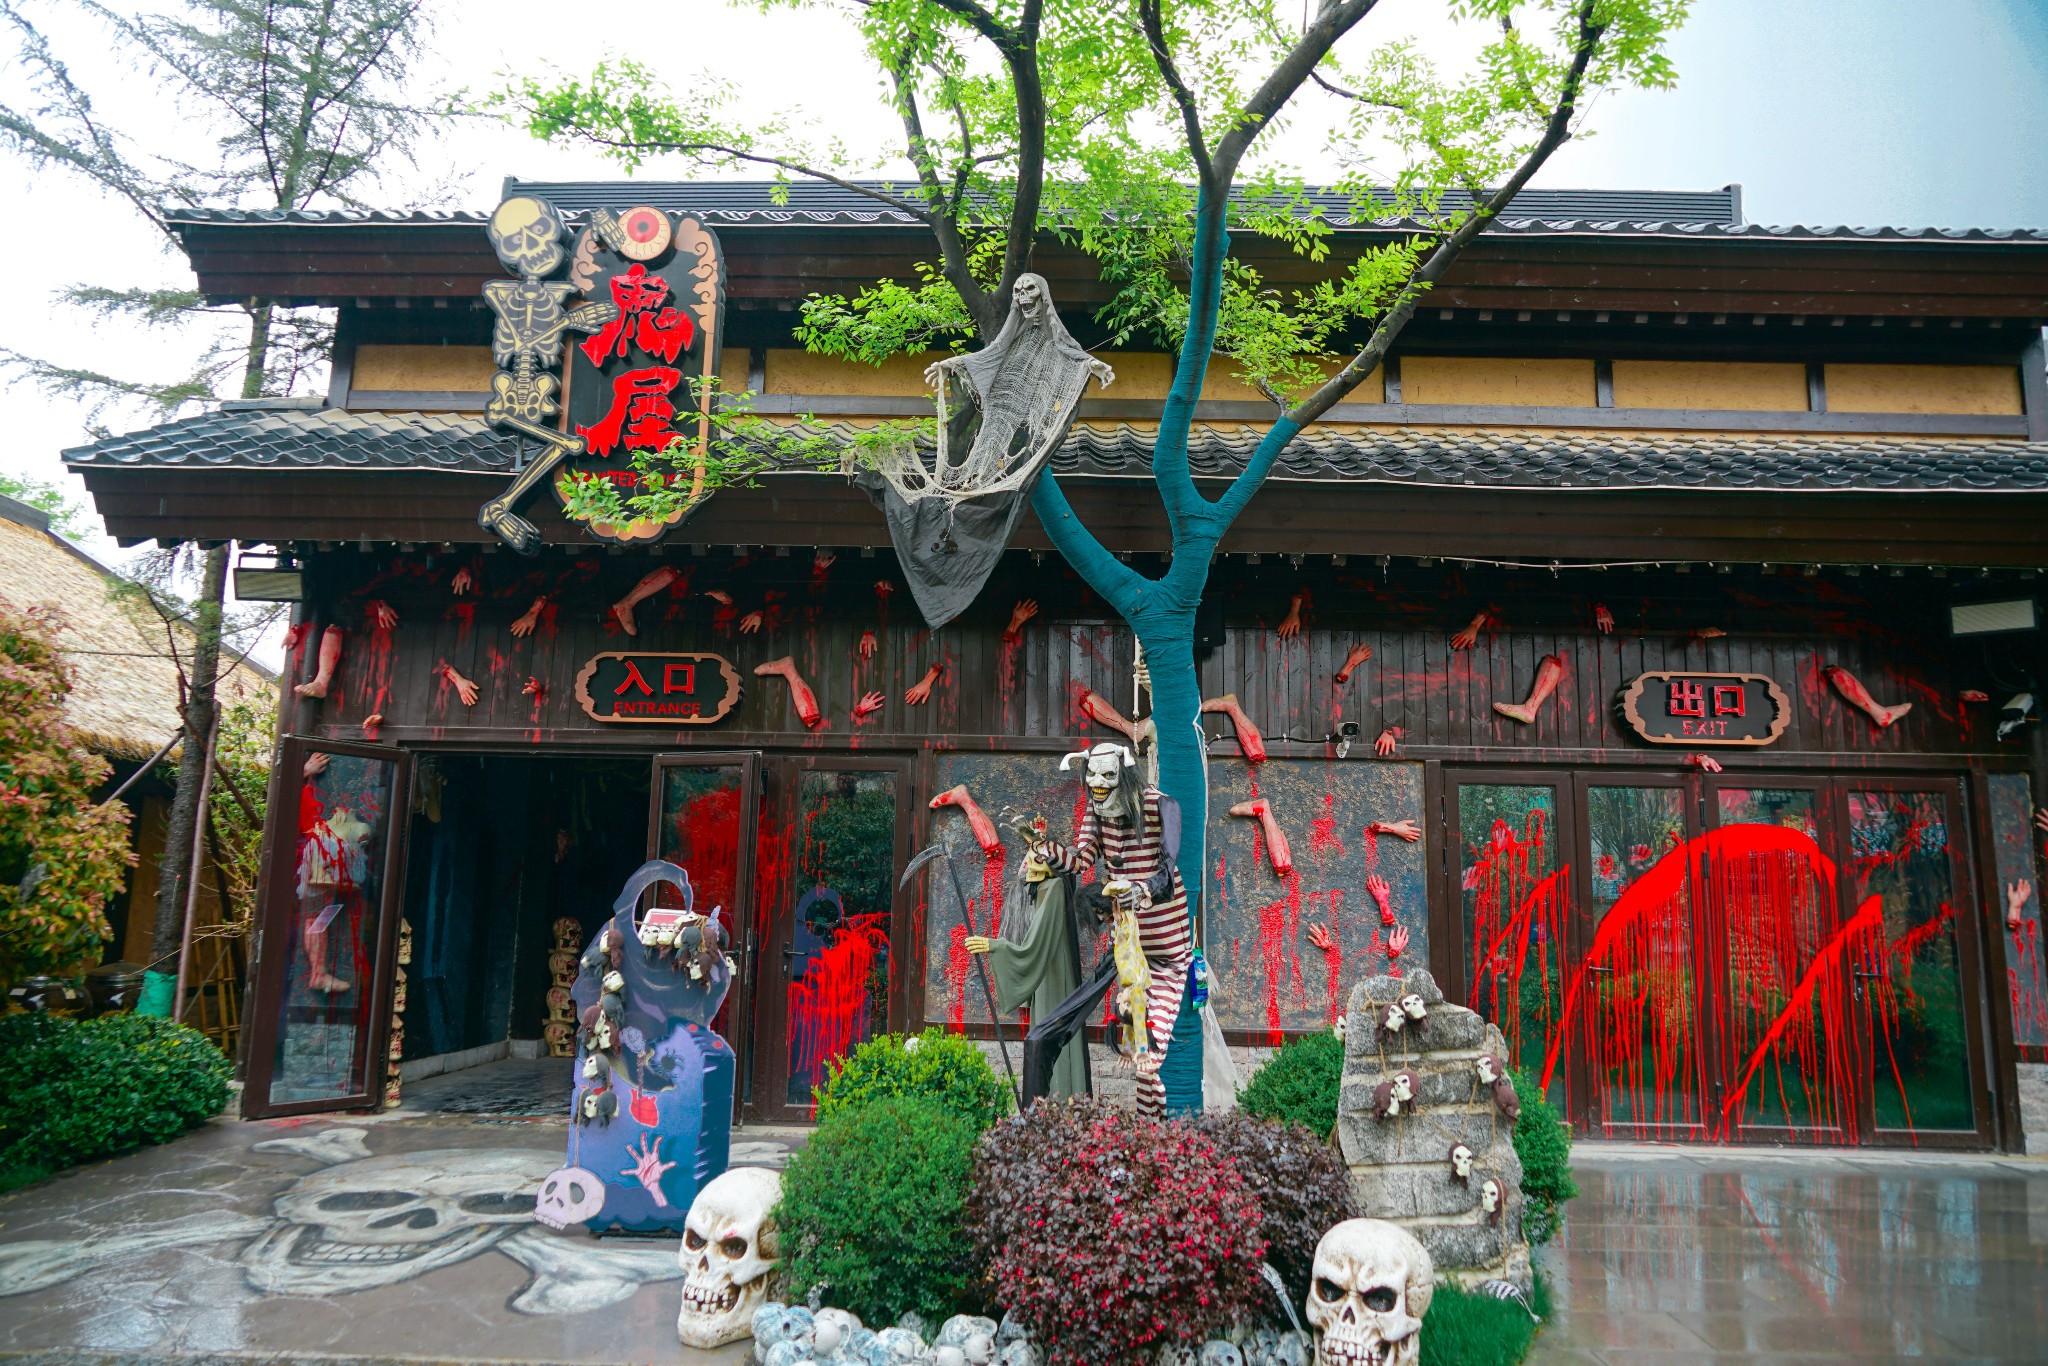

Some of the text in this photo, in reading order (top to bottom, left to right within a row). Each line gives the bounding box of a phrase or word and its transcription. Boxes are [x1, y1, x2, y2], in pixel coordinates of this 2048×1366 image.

[575, 263, 694, 457] 鬼屋
[614, 660, 695, 696] 入口
[613, 701, 701, 716] ENTRANCE
[1670, 680, 1746, 718] 出口
[1682, 719, 1728, 736] EXIT
